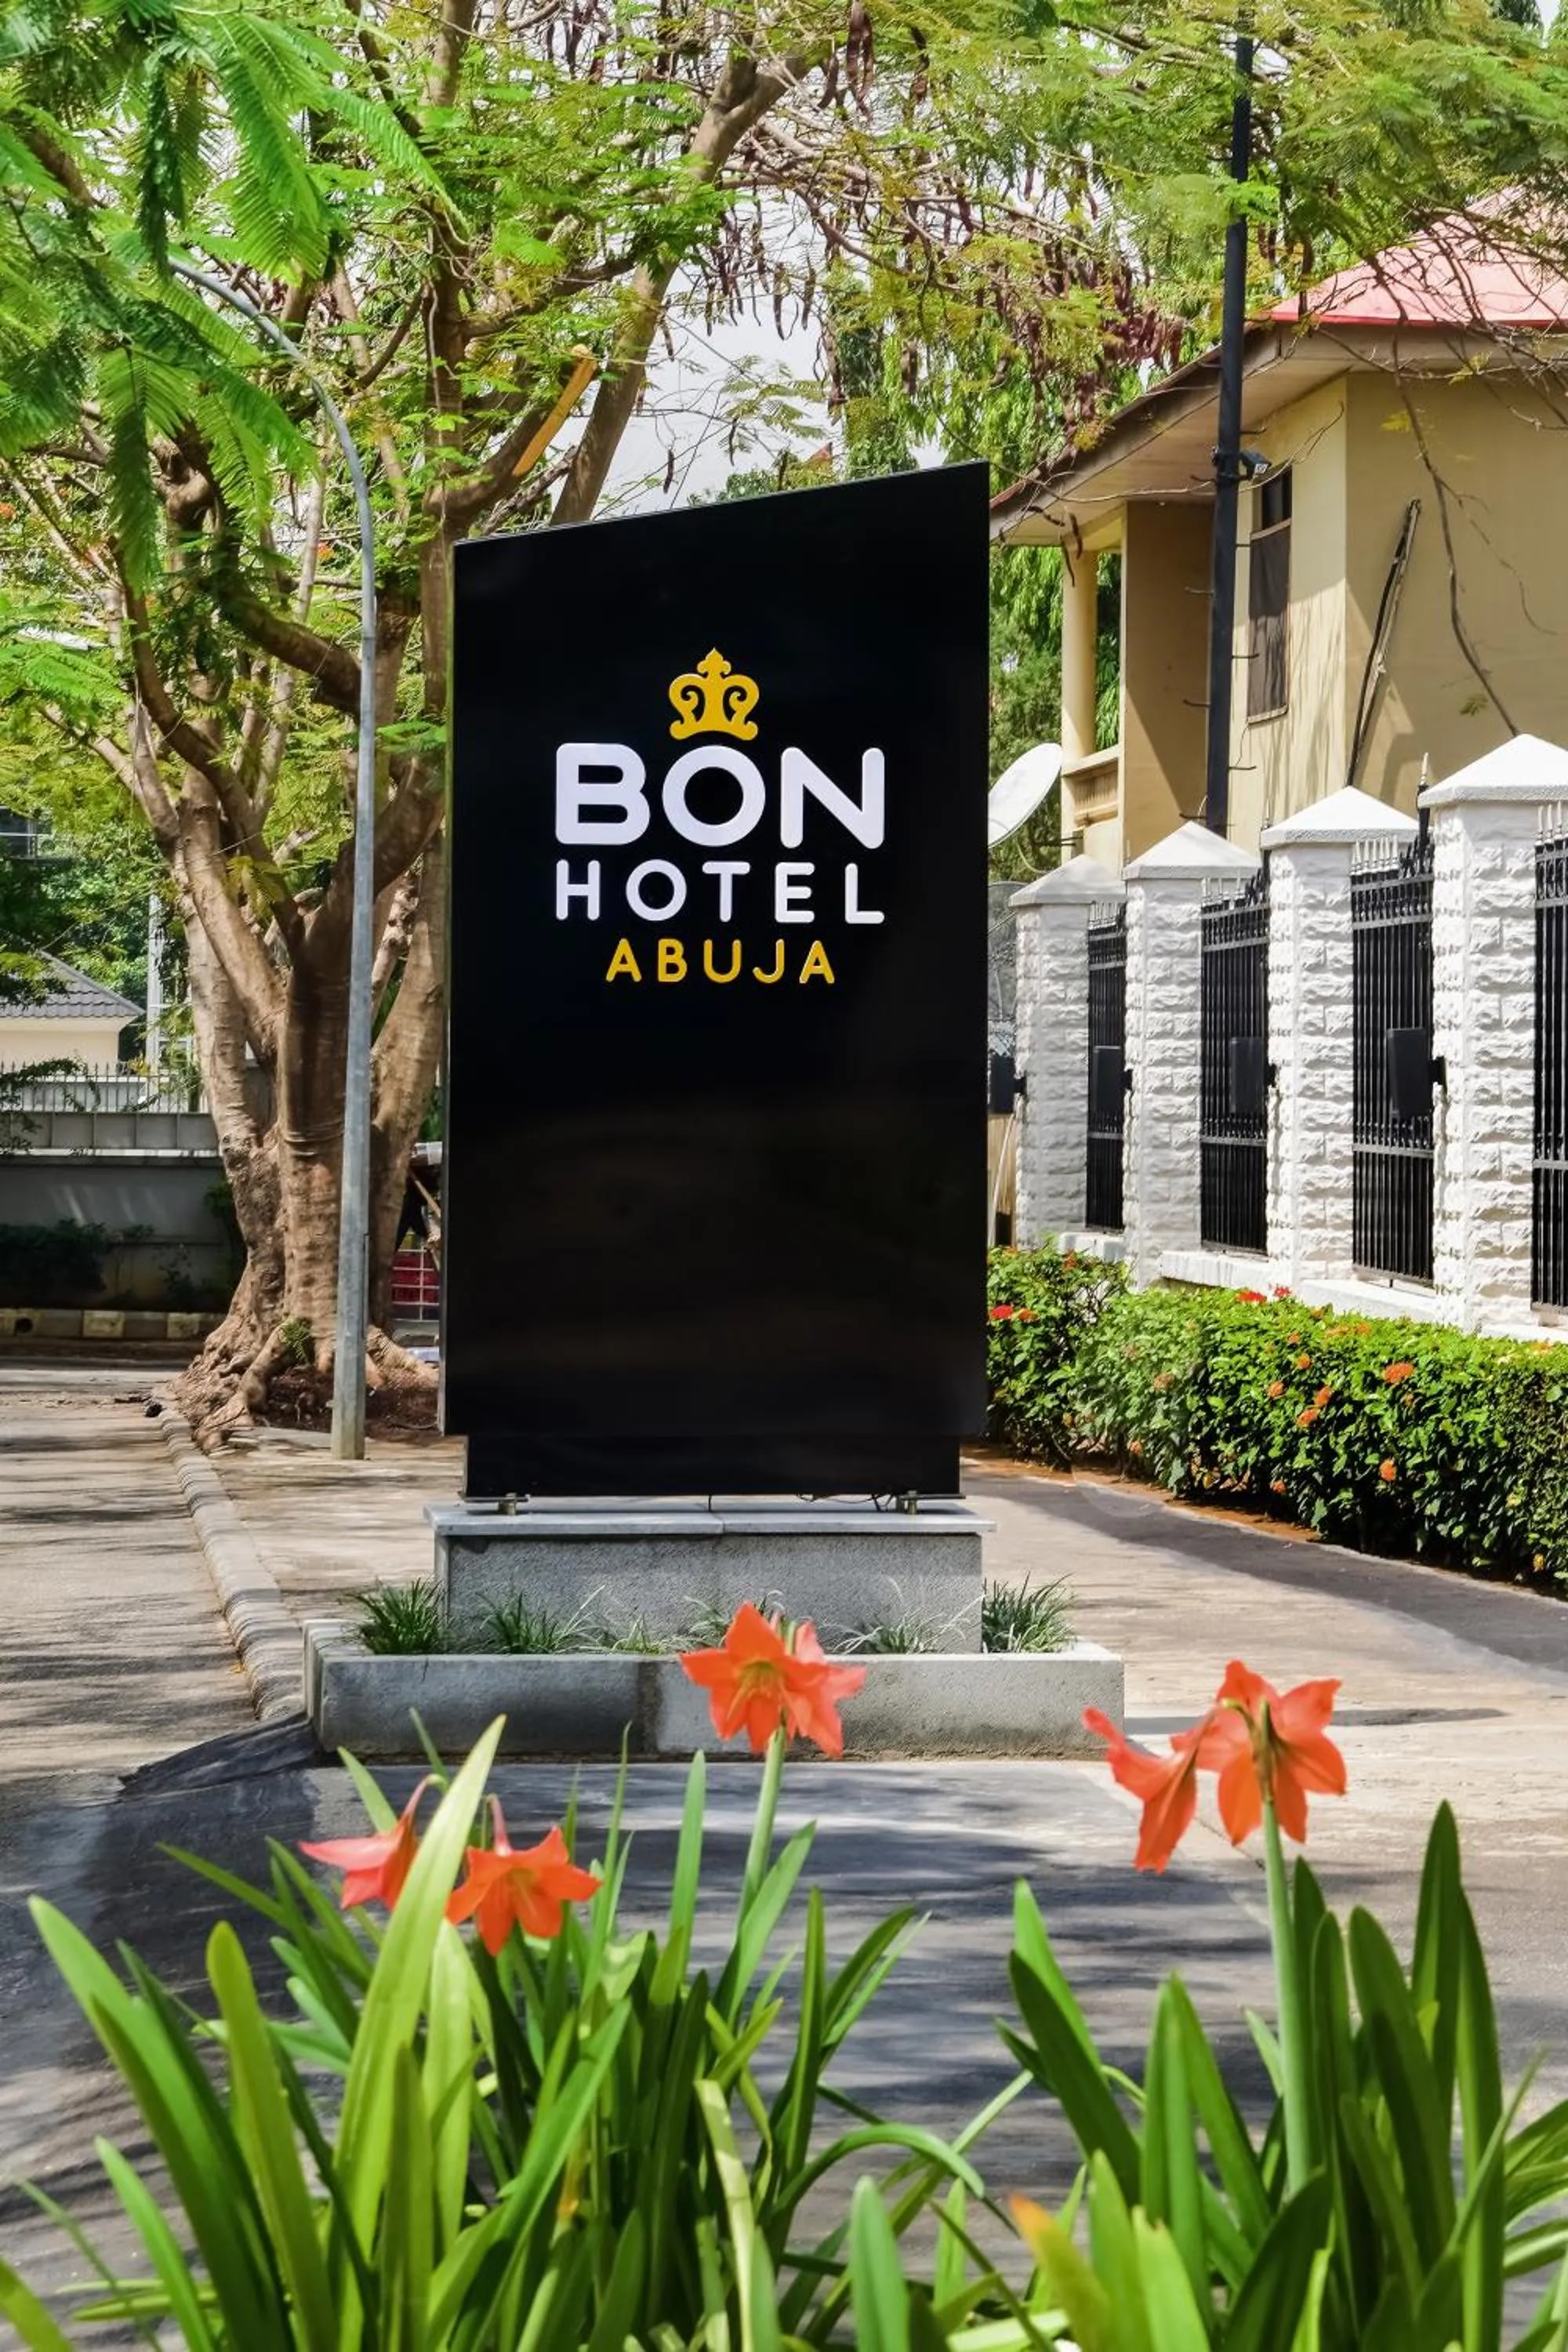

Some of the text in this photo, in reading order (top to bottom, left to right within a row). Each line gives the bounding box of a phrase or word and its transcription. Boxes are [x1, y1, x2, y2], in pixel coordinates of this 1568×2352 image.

[555, 742, 886, 849] BON
[555, 858, 886, 924] HOTEL
[605, 938, 835, 984] ABUJA
